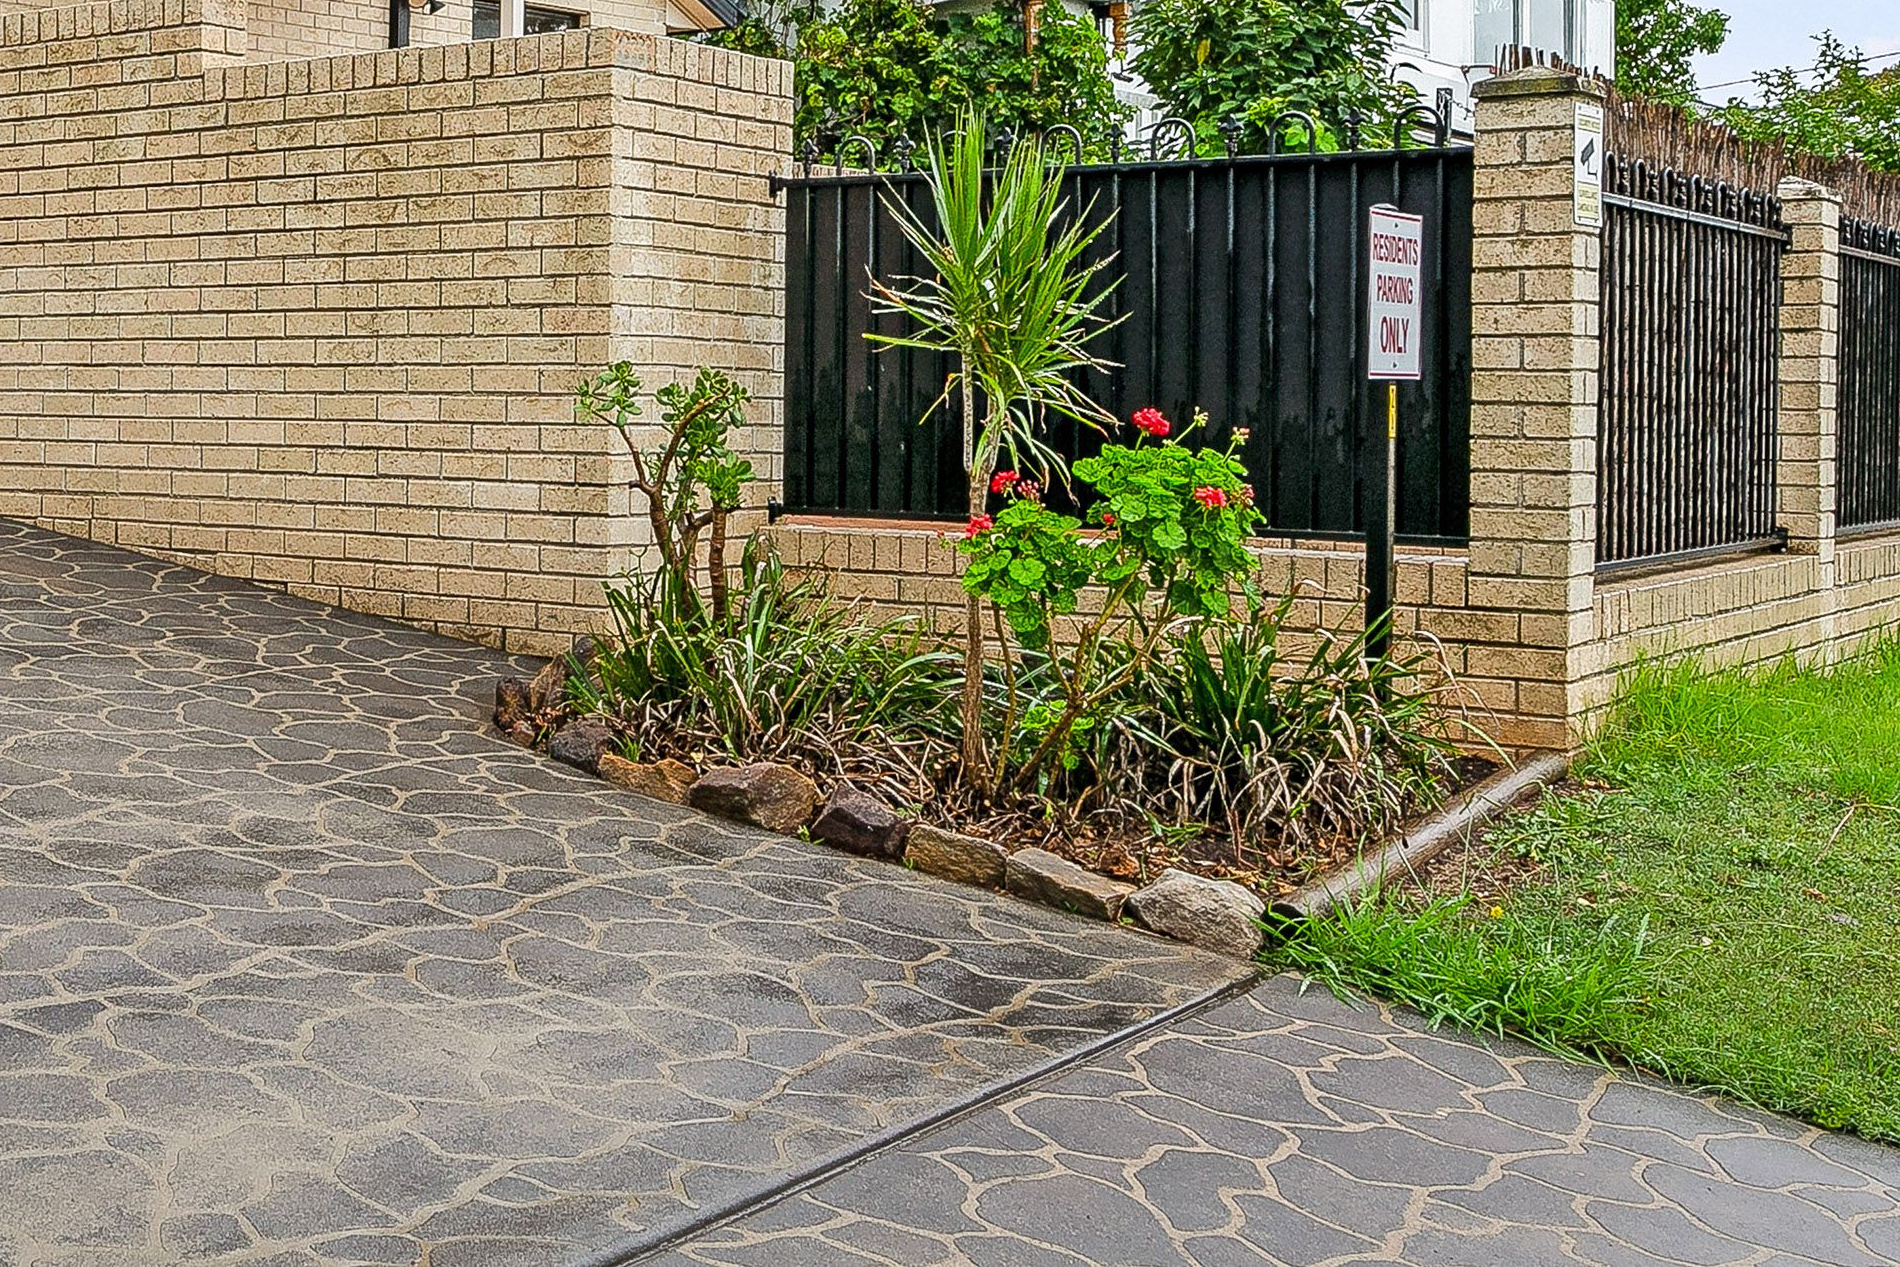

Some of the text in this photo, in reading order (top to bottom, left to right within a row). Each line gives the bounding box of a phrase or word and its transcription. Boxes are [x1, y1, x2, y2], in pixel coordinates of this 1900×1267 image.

[1372, 233, 1419, 266] RESIDENTS
[1376, 274, 1414, 305] PARKING
[1380, 316, 1410, 354] ONLY
